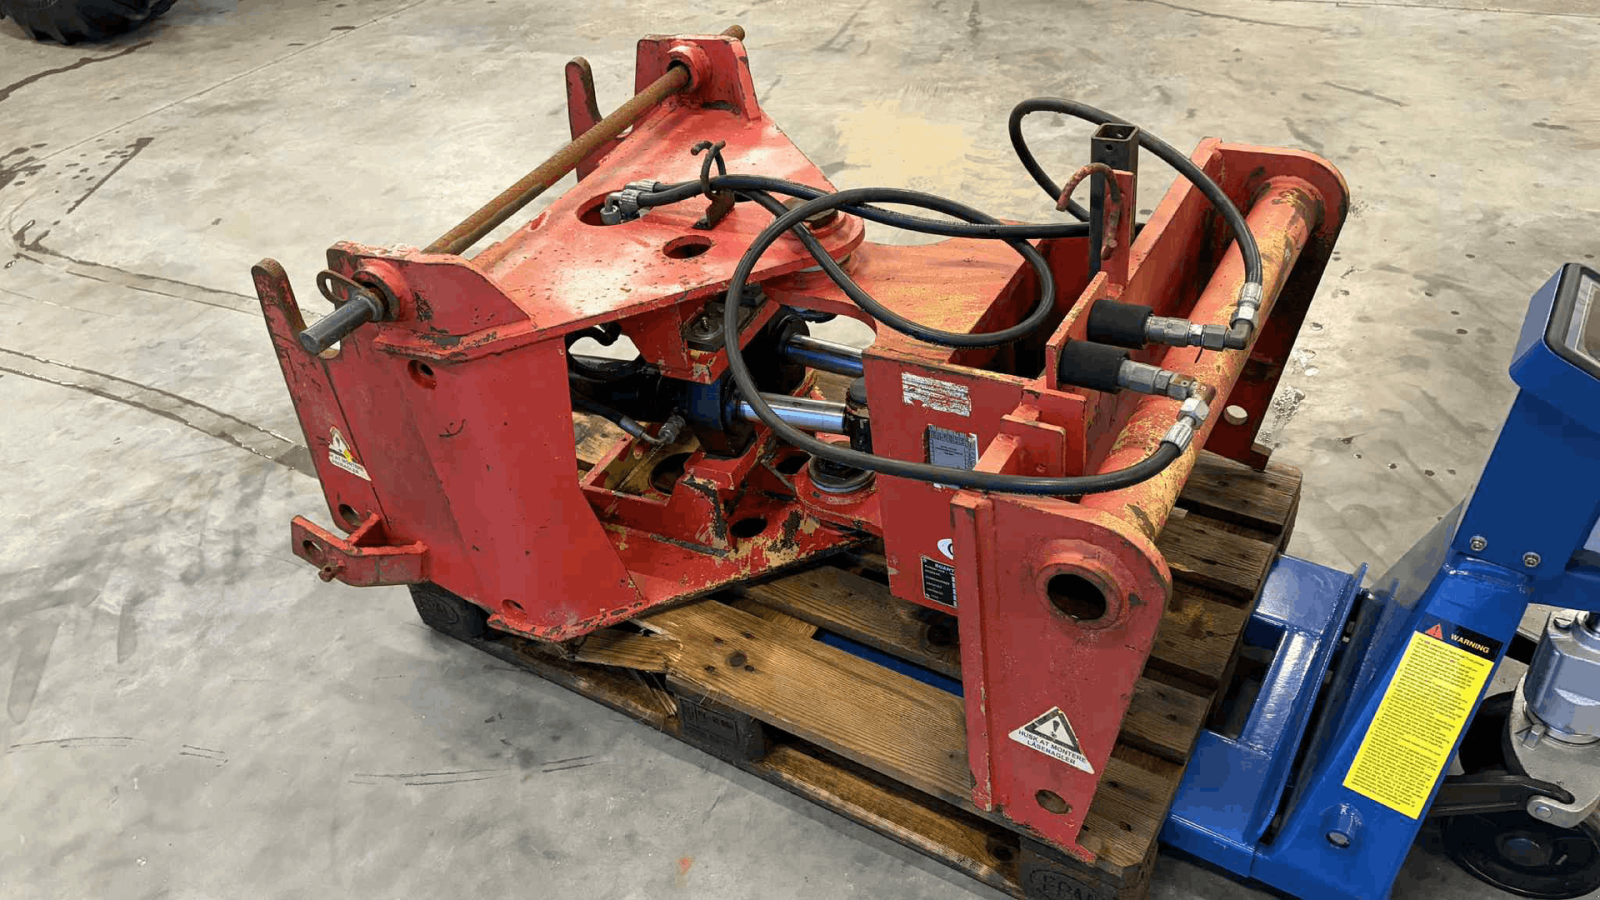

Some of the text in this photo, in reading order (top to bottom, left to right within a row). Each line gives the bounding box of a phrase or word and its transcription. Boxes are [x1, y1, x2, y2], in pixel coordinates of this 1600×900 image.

[1450, 633, 1490, 654] WARNING
[1018, 729, 1087, 764] HUSK AT MONTERE
